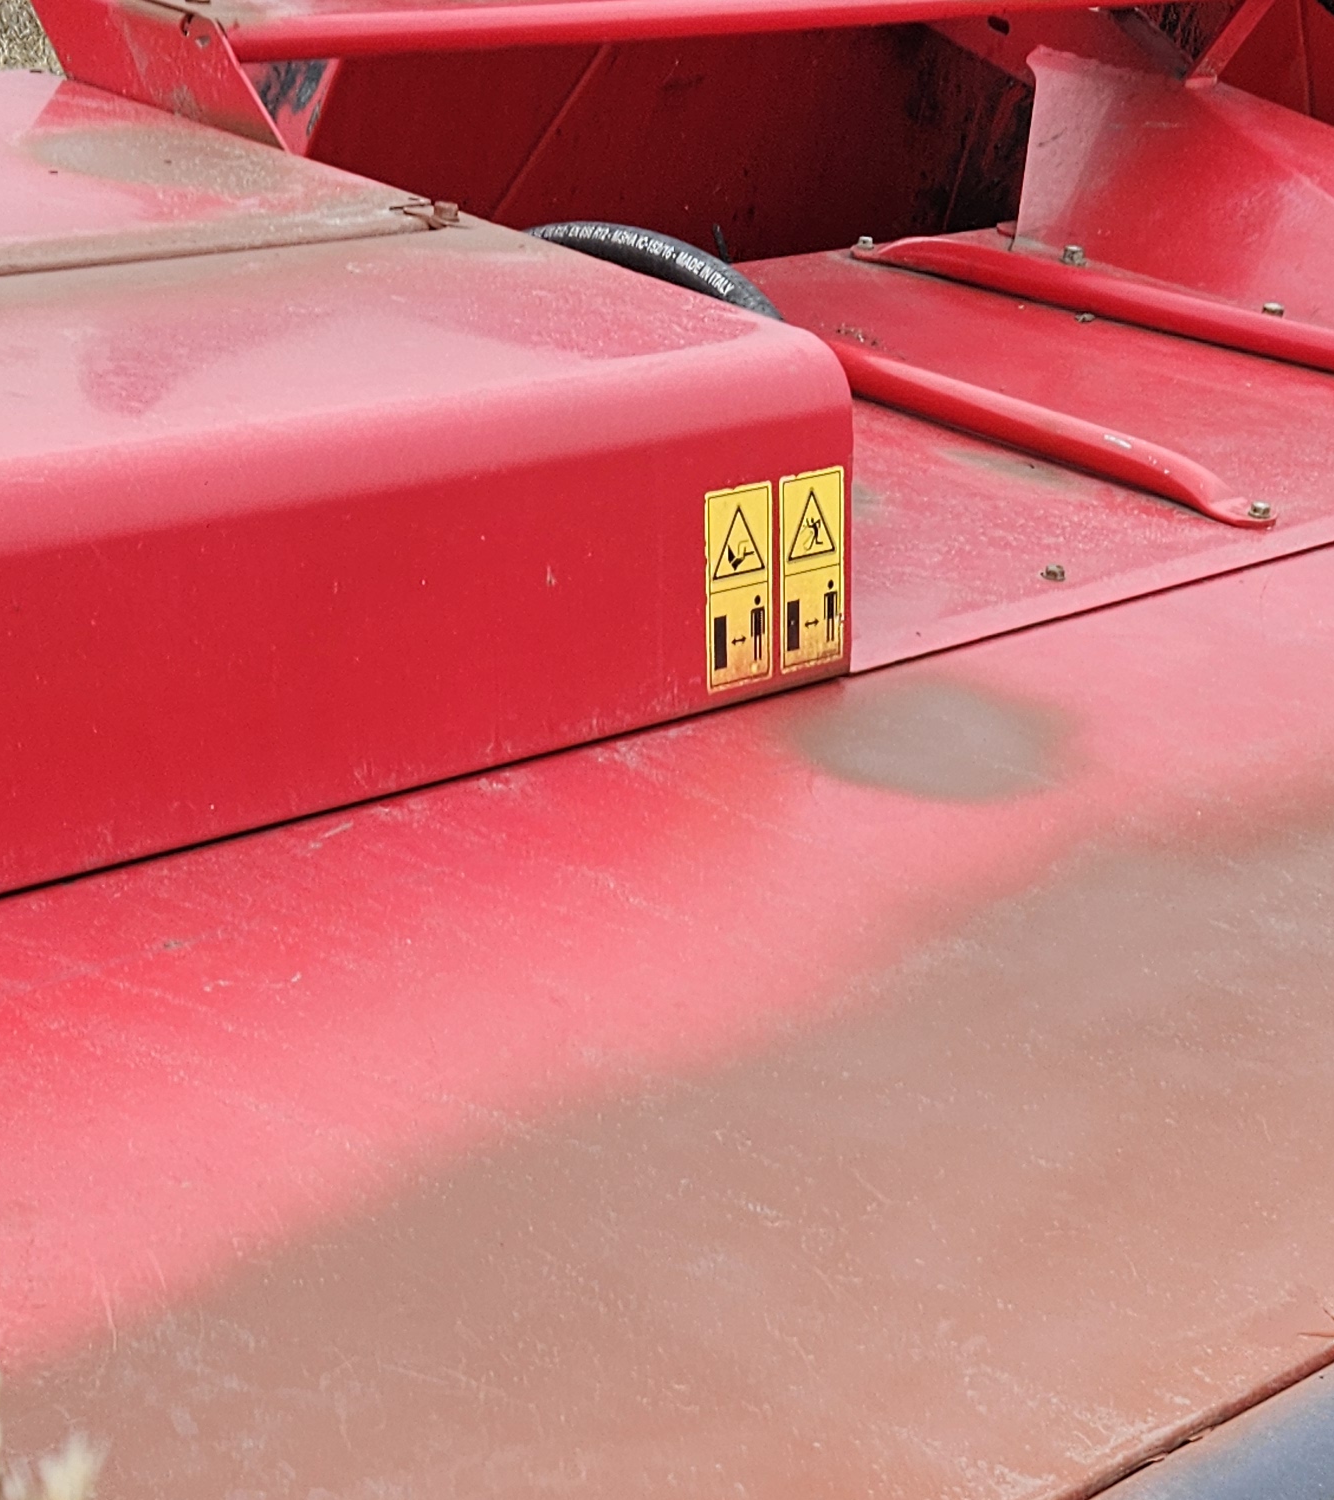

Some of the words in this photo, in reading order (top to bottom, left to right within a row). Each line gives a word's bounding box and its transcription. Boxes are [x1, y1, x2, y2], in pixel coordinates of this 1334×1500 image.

[611, 229, 638, 247] MSHA
[675, 251, 704, 275] MADE
[699, 264, 715, 281] IN
[708, 271, 735, 296] ITALY
